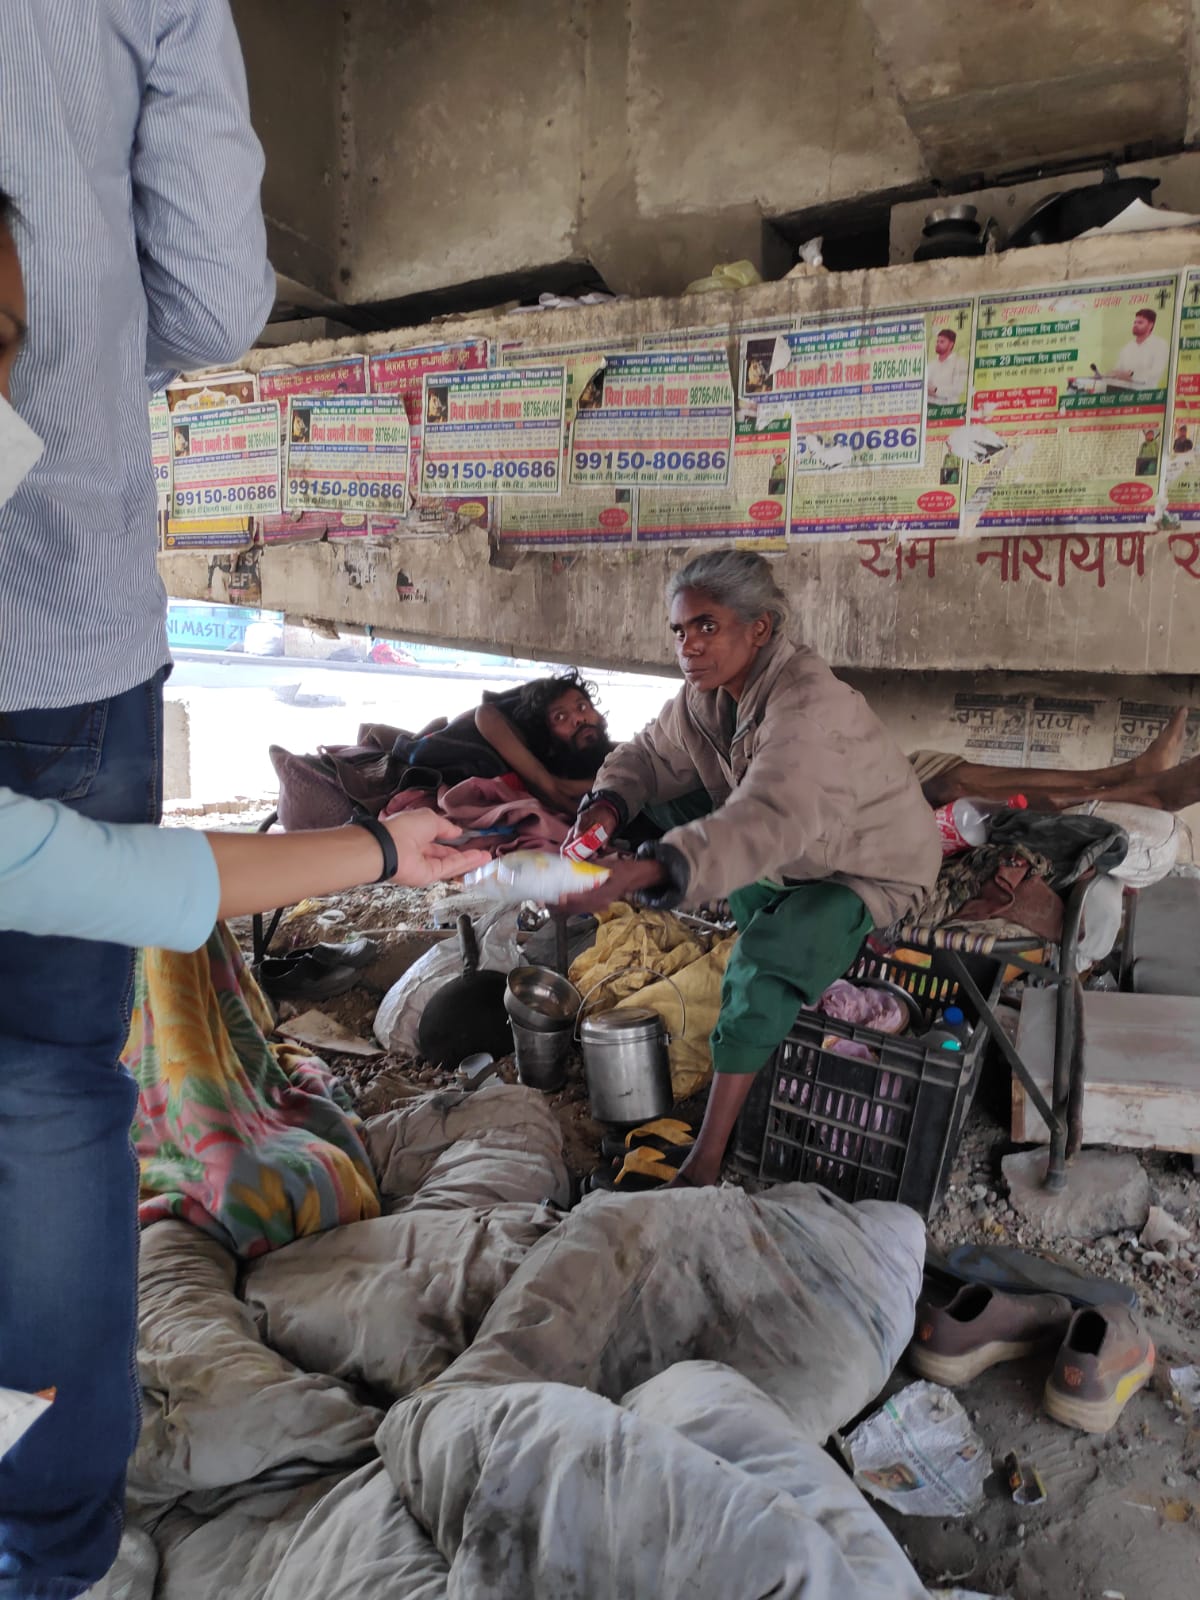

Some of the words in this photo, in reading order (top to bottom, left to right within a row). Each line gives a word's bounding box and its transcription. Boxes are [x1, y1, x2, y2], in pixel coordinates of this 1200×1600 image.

[873, 357, 922, 380] 98766-00144
[575, 451, 727, 470] 99150-80686
[426, 461, 557, 480] 99150-80686
[176, 484, 277, 506] 99150-80686
[290, 480, 403, 499] 99150-80686
[857, 536, 956, 581] राम
[976, 532, 1161, 588] नारायण
[182, 620, 226, 639] MASTI
